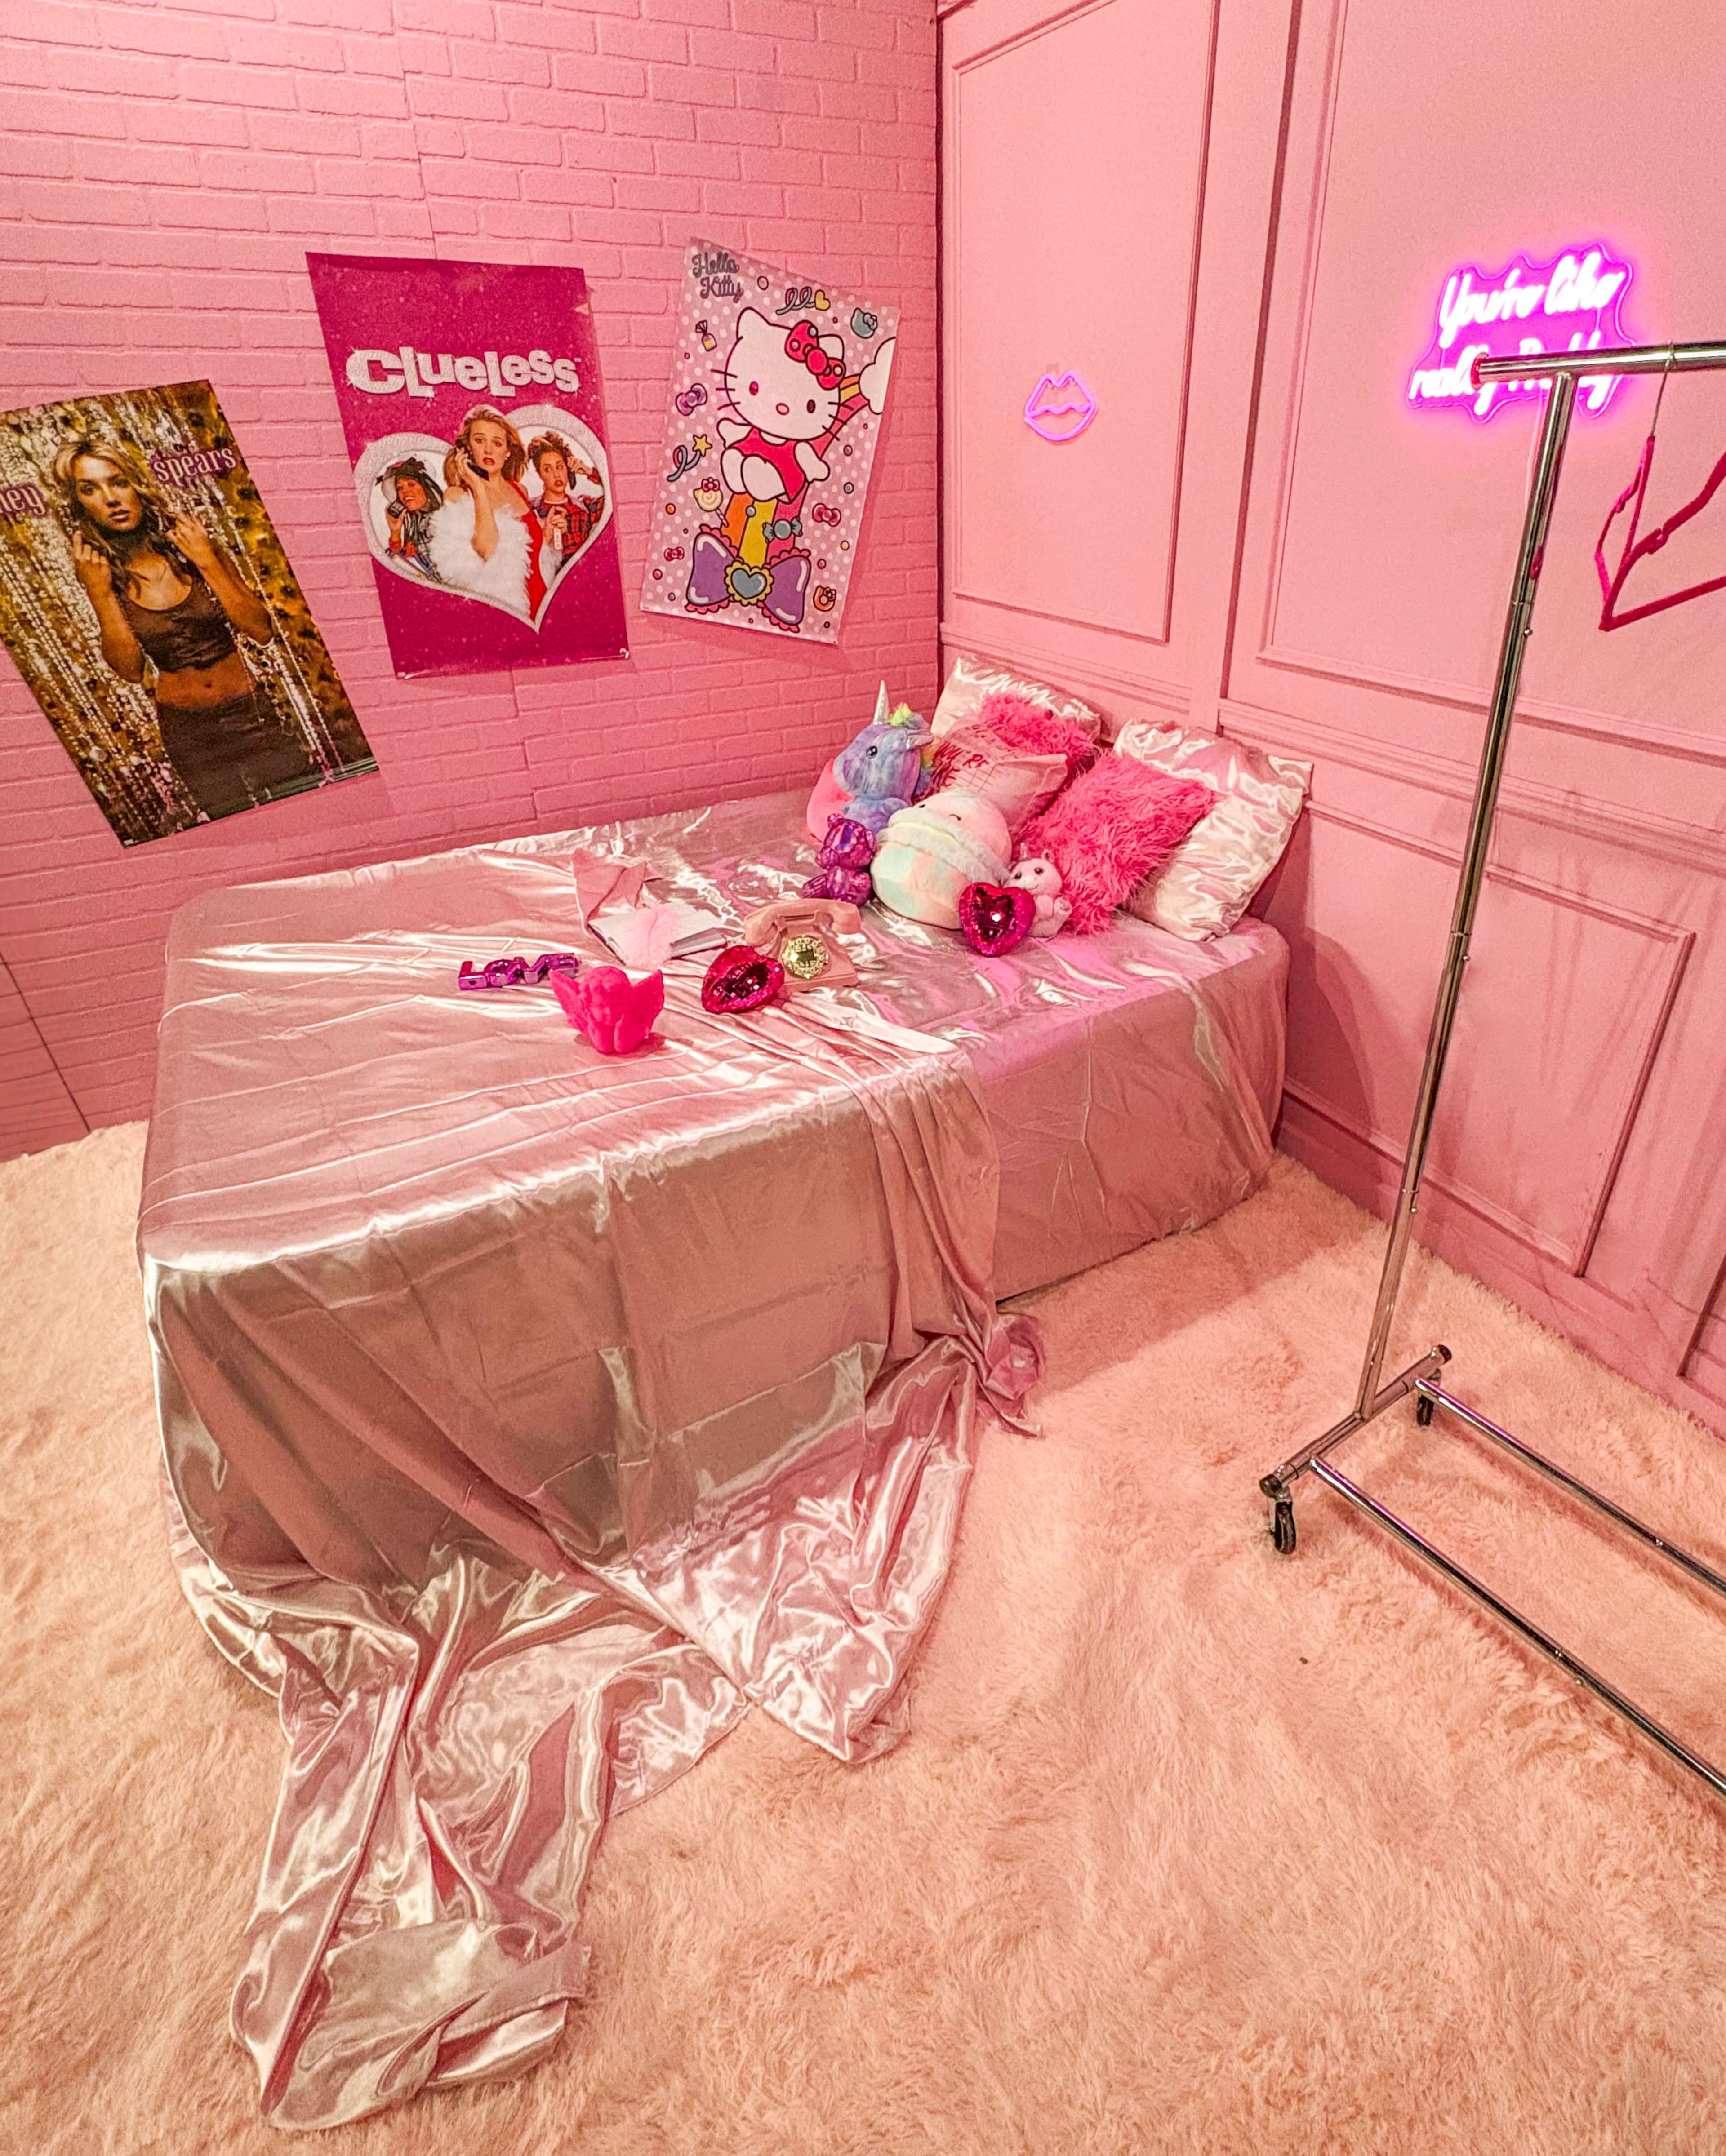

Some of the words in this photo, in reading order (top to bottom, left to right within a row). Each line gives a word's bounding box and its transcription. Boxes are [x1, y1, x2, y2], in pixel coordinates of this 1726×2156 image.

[692, 251, 740, 278] Hello
[699, 275, 744, 304] Kitty
[1439, 269, 1546, 349] You're
[1544, 252, 1626, 315] like
[153, 447, 236, 487] spears
[458, 952, 579, 990] LOVE
